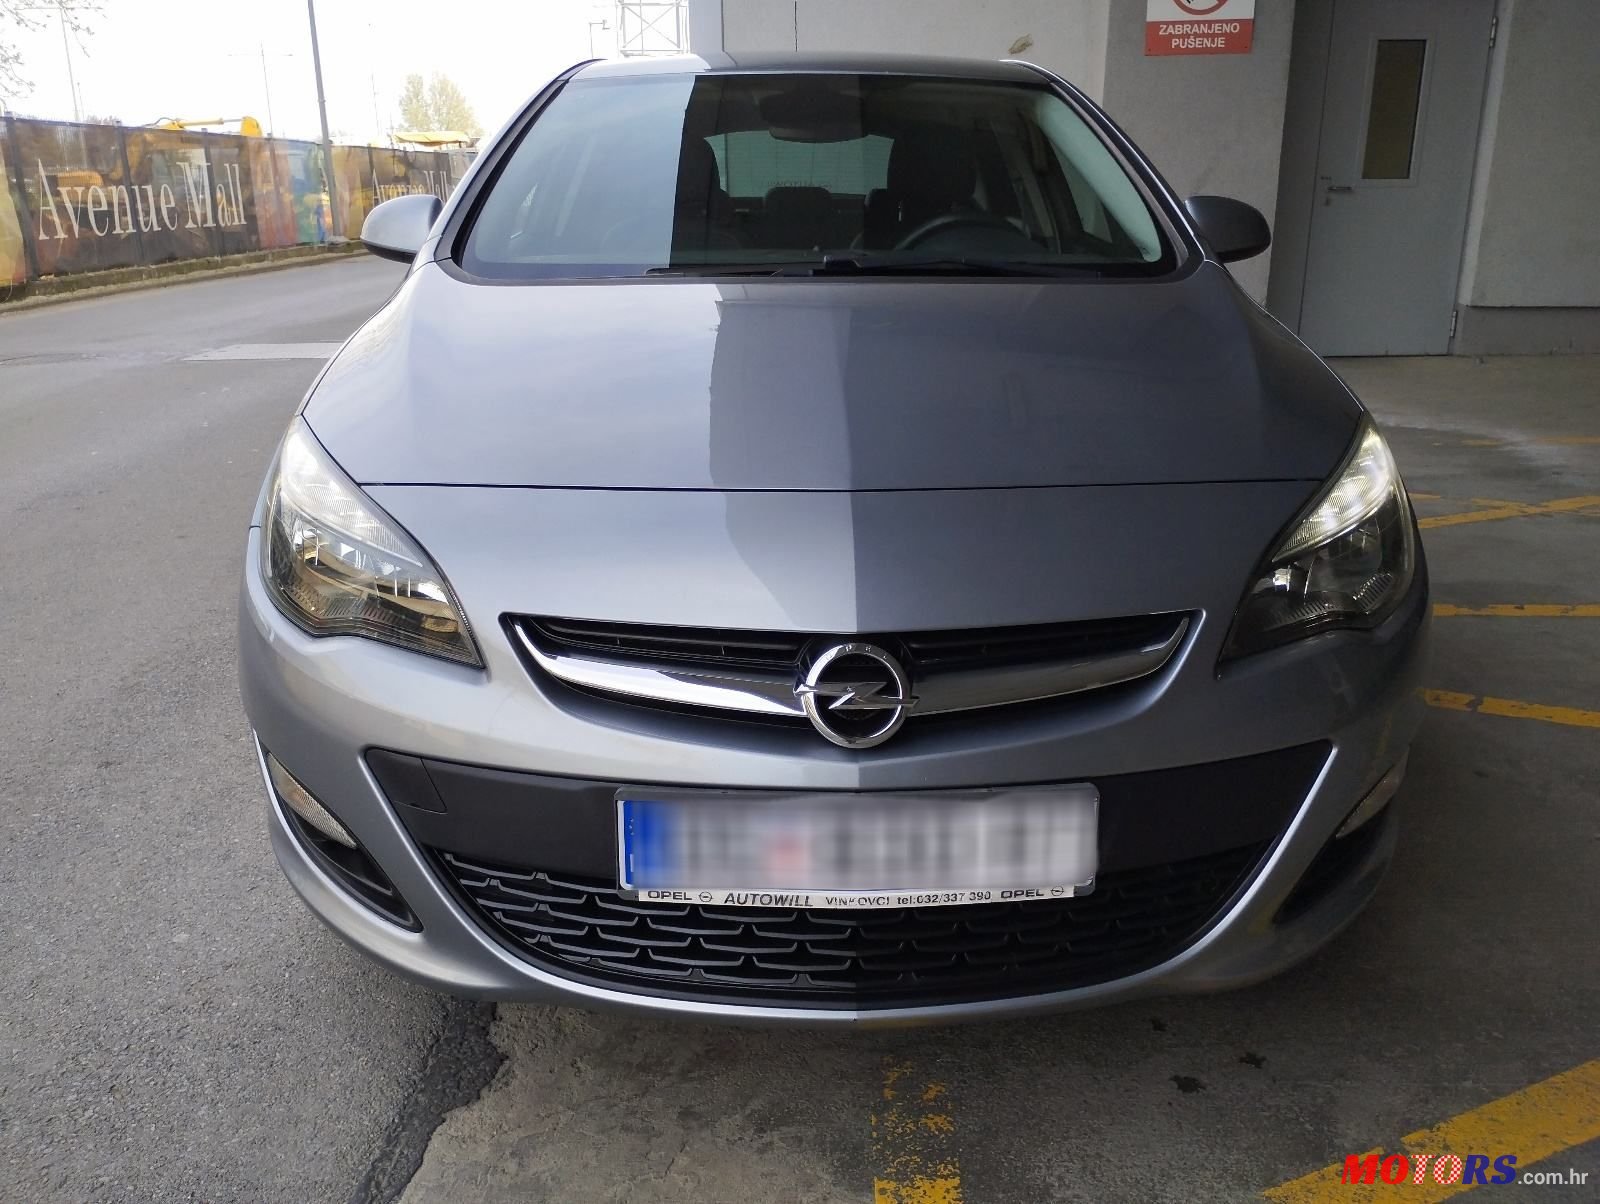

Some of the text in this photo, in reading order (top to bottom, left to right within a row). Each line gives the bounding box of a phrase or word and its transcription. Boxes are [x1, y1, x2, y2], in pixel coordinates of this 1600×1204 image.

[1159, 22, 1240, 35] ZABRANJENO
[1171, 35, 1226, 49] PUŠENJE
[38, 158, 247, 241] Avenue Mall
[647, 890, 692, 901] OPEL
[724, 892, 814, 907] AUTOWILL
[1000, 888, 1045, 899] OPEL
